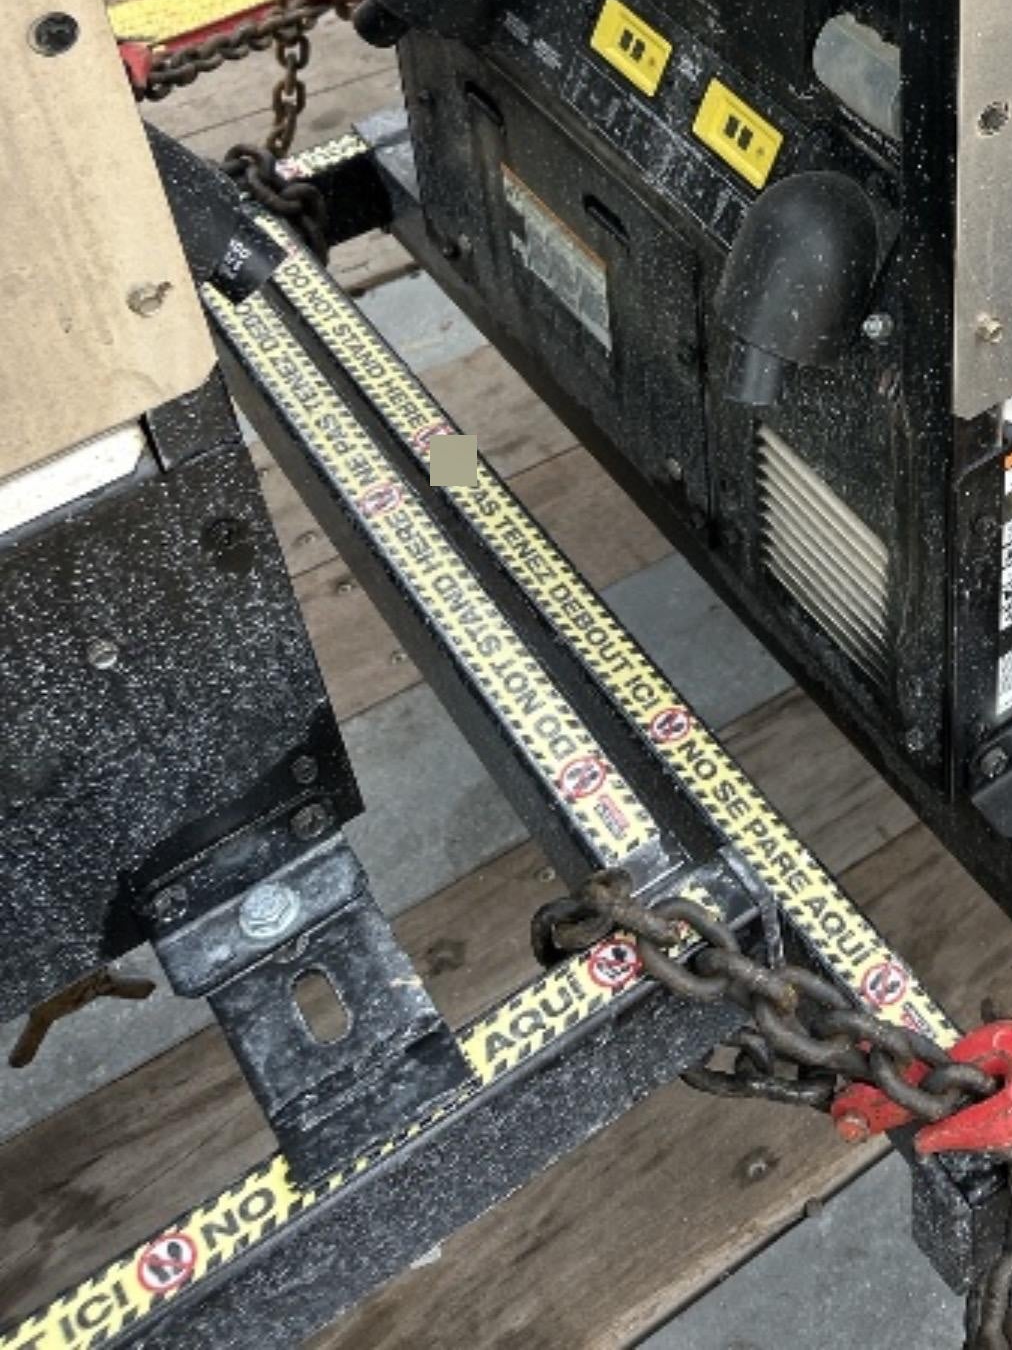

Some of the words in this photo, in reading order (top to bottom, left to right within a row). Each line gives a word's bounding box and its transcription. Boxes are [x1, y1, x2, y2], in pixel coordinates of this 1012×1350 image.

[282, 262, 312, 289] DO
[304, 287, 341, 322] NOT
[332, 321, 387, 379] STAND
[378, 377, 432, 431] HERE
[384, 507, 444, 574] HERE
[431, 572, 501, 658] STAND
[497, 514, 559, 586] TENEZ
[548, 581, 636, 674] DEBOUT
[623, 673, 662, 712] ICI
[488, 657, 547, 716] NOT
[532, 712, 577, 758] DO
[676, 738, 718, 781] NO
[711, 779, 753, 821] SE
[742, 817, 814, 895] PARE
[200, 1186, 278, 1248] NO
[58, 1279, 130, 1344] ICI
